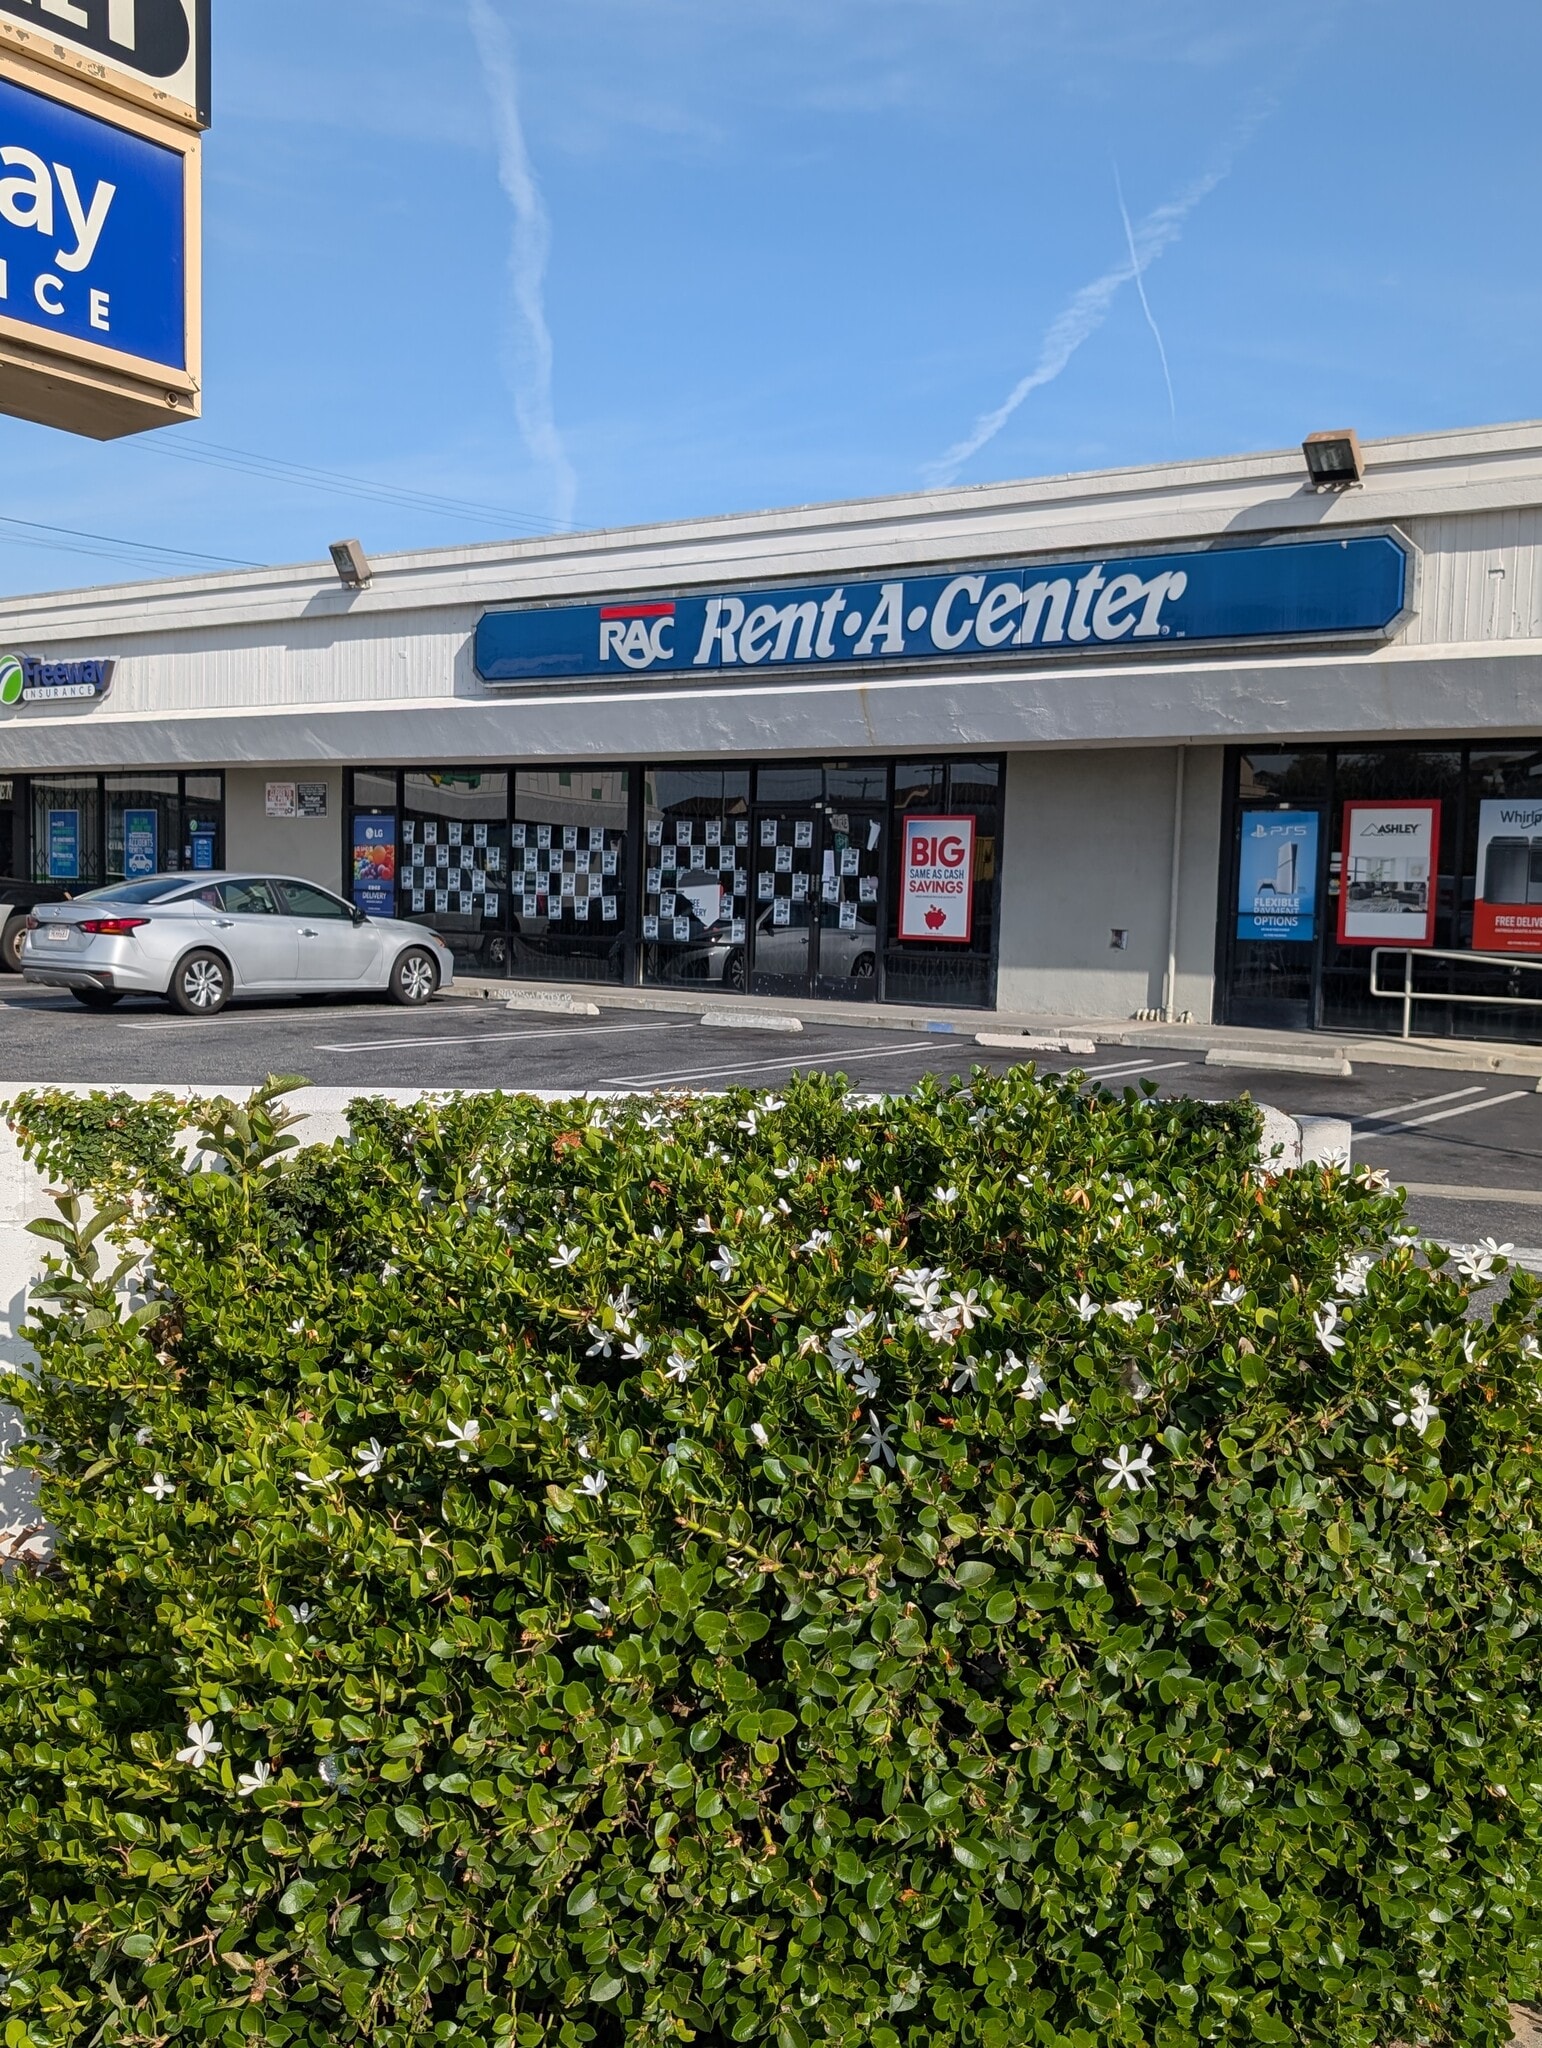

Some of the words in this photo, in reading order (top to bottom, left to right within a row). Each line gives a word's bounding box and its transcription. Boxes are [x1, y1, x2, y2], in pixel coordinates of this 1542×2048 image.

[599, 616, 675, 670] RAC
[23, 656, 113, 690] Freeway
[25, 686, 93, 699] INSURANCE
[1270, 826, 1307, 835] PS5
[1377, 823, 1418, 834] ASHLEY
[911, 836, 965, 868] BIG
[910, 869, 930, 879] SAME
[932, 869, 943, 879] AS
[944, 869, 965, 879] CASH
[909, 880, 964, 894] SAVINGS
[362, 891, 386, 900] DELIVERY
[1254, 898, 1300, 907] FLEXIBLE
[1253, 916, 1299, 926] OPTIONS
[1495, 915, 1515, 926] FREE
